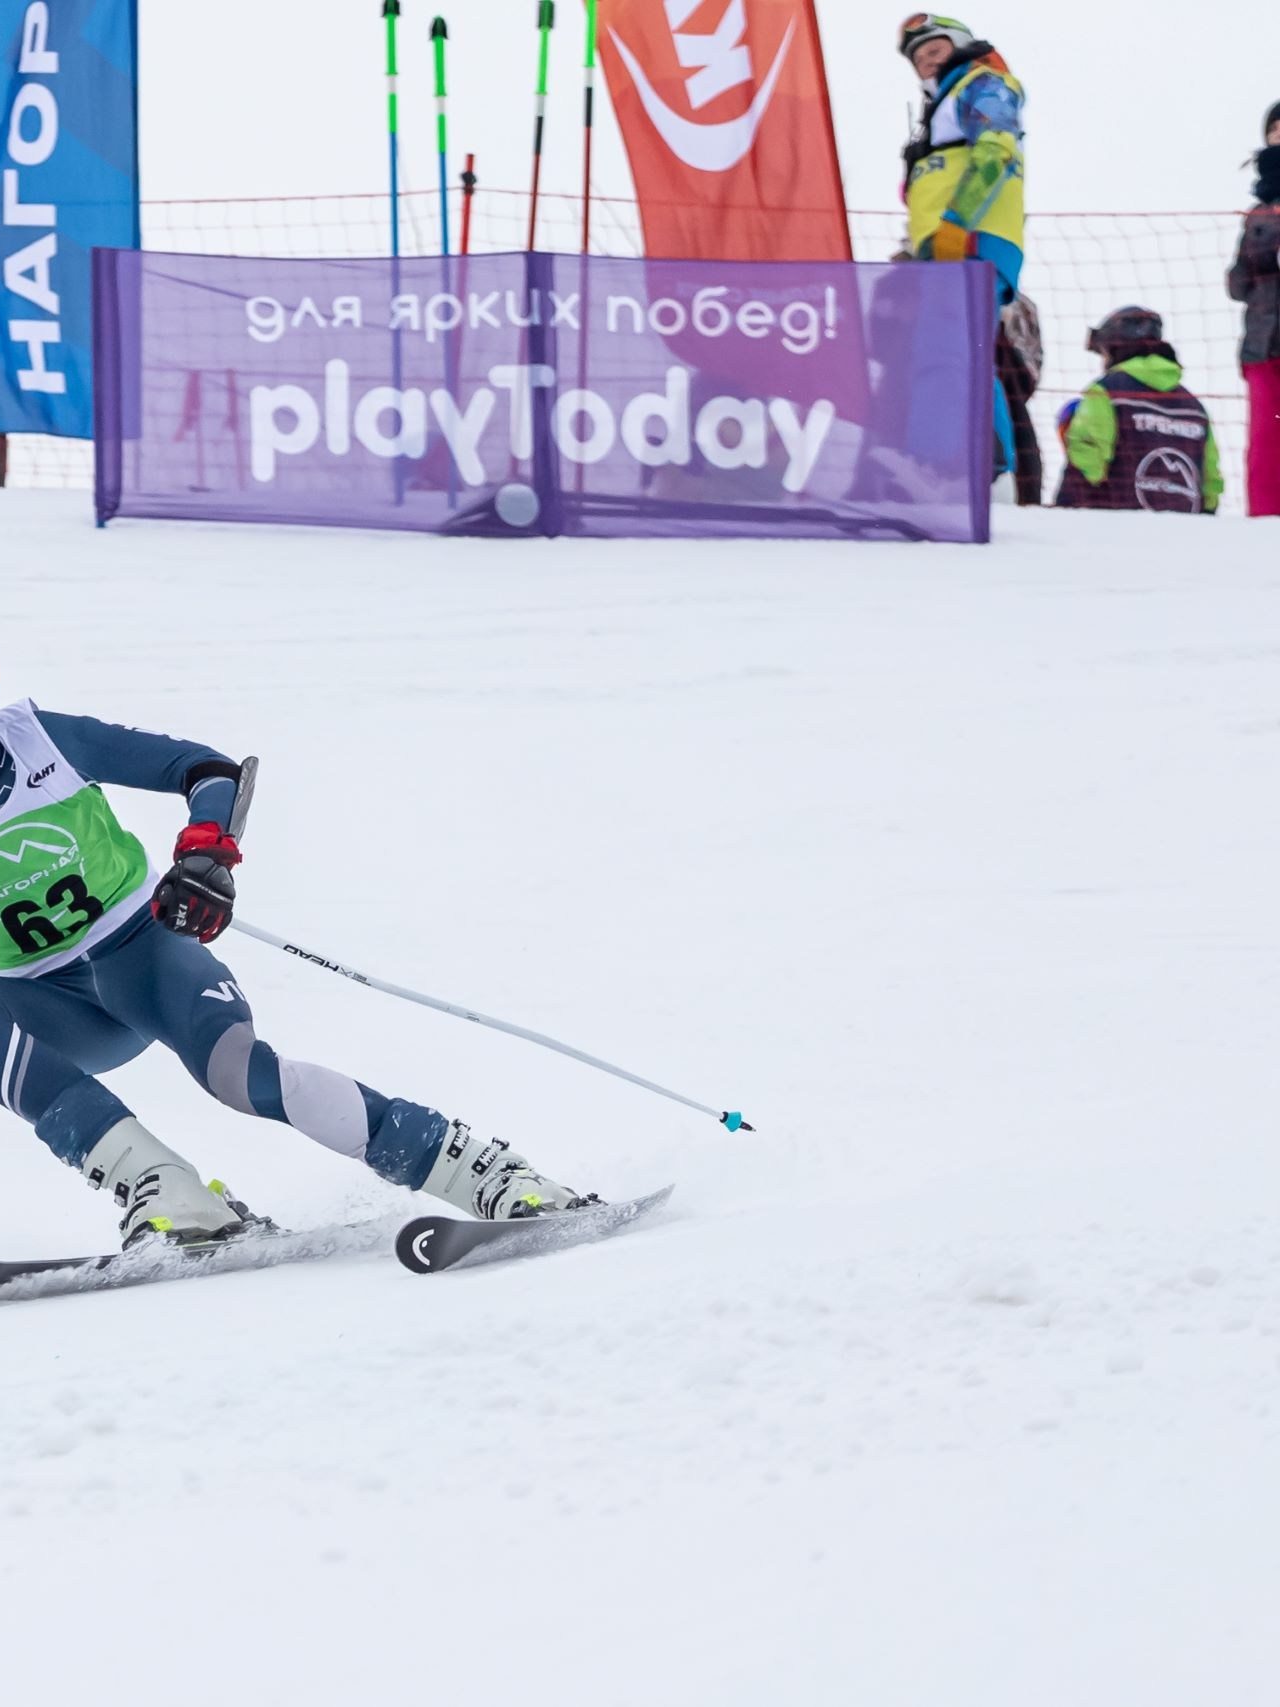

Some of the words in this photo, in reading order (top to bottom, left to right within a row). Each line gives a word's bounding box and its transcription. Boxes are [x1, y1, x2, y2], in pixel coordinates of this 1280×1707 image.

[3, 1, 67, 393] НАГОР
[245, 296, 362, 343] для
[388, 289, 580, 343] ярких
[250, 358, 836, 493] playToday
[0, 874, 105, 955] 63
